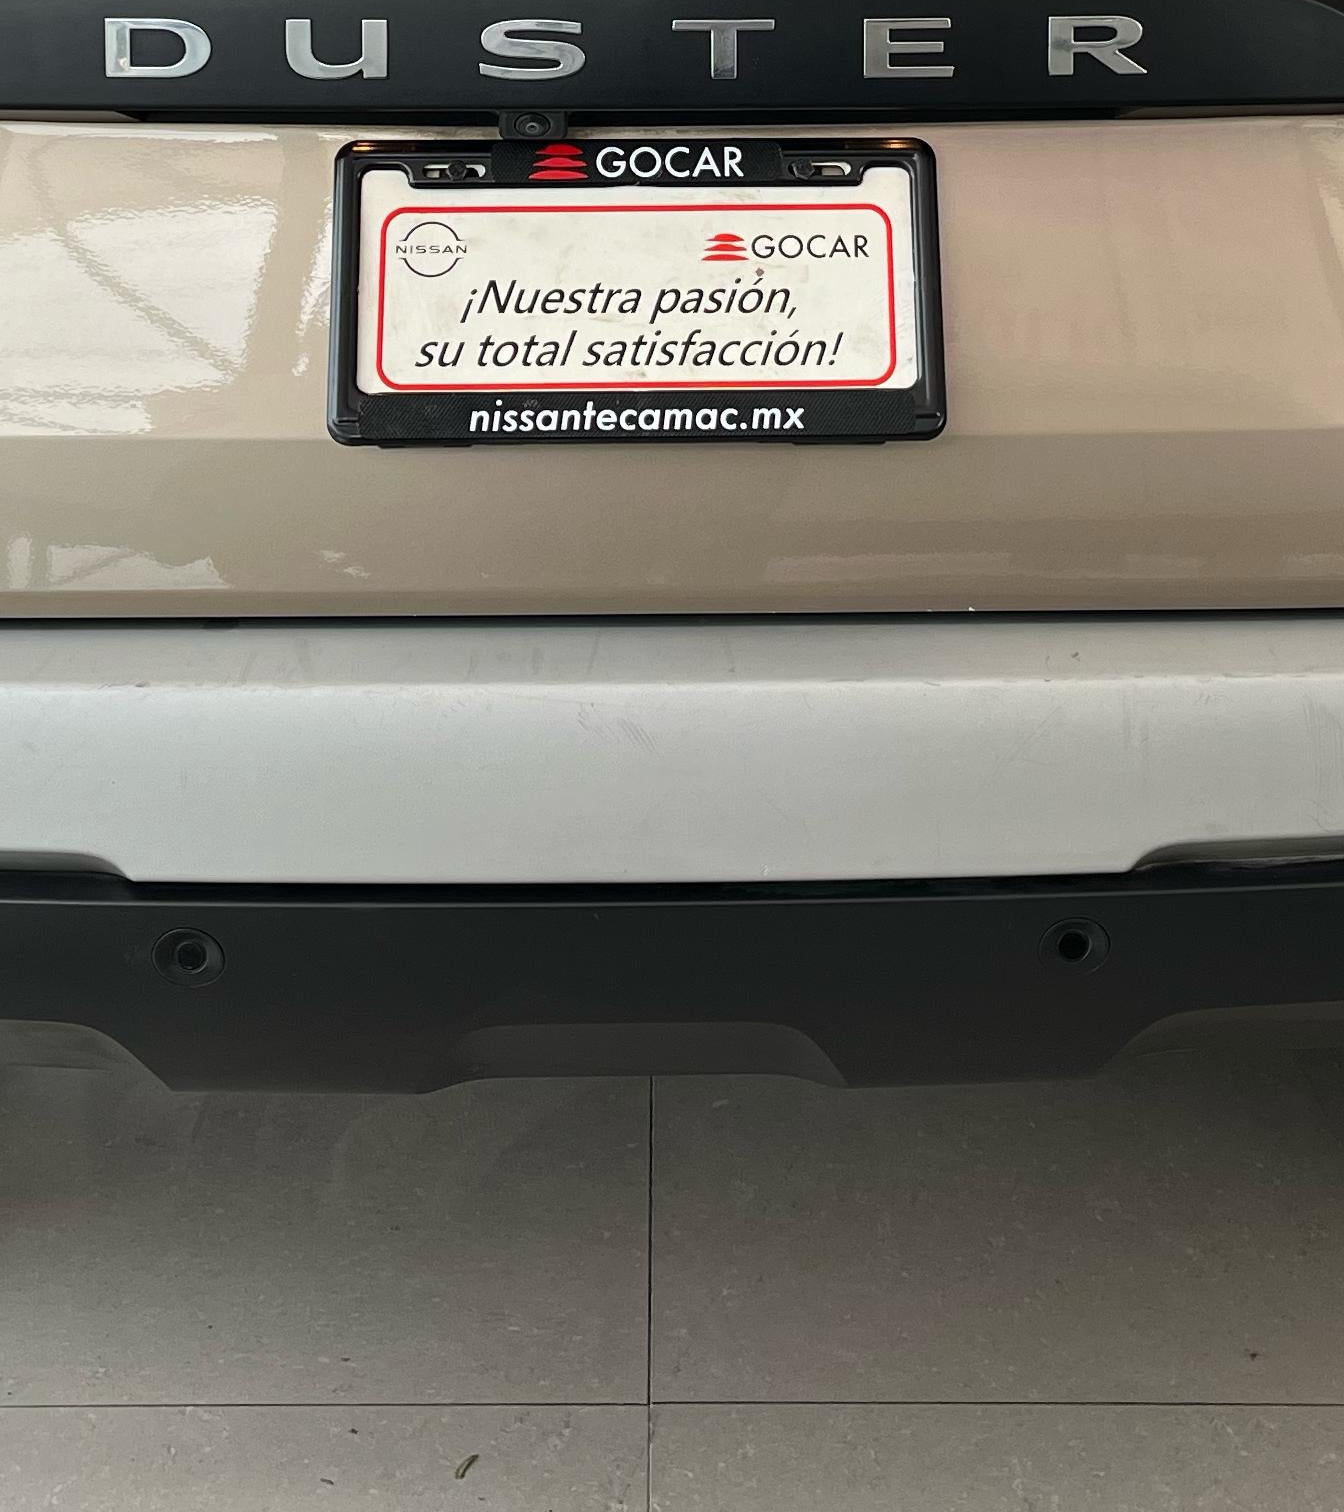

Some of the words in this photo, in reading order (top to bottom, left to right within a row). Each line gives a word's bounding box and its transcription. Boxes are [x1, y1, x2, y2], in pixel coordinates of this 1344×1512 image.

[102, 15, 1150, 80] DUSTER
[595, 146, 745, 179] GOCAR
[395, 244, 468, 255] NISSAN
[751, 234, 870, 260] GOCAR
[460, 279, 642, 324] ¡Nuestra
[649, 276, 798, 325] pasión,
[414, 341, 465, 369] su
[477, 330, 578, 368] total
[582, 329, 844, 368] satisfacción!
[469, 399, 805, 433] nissantecamac.mx
